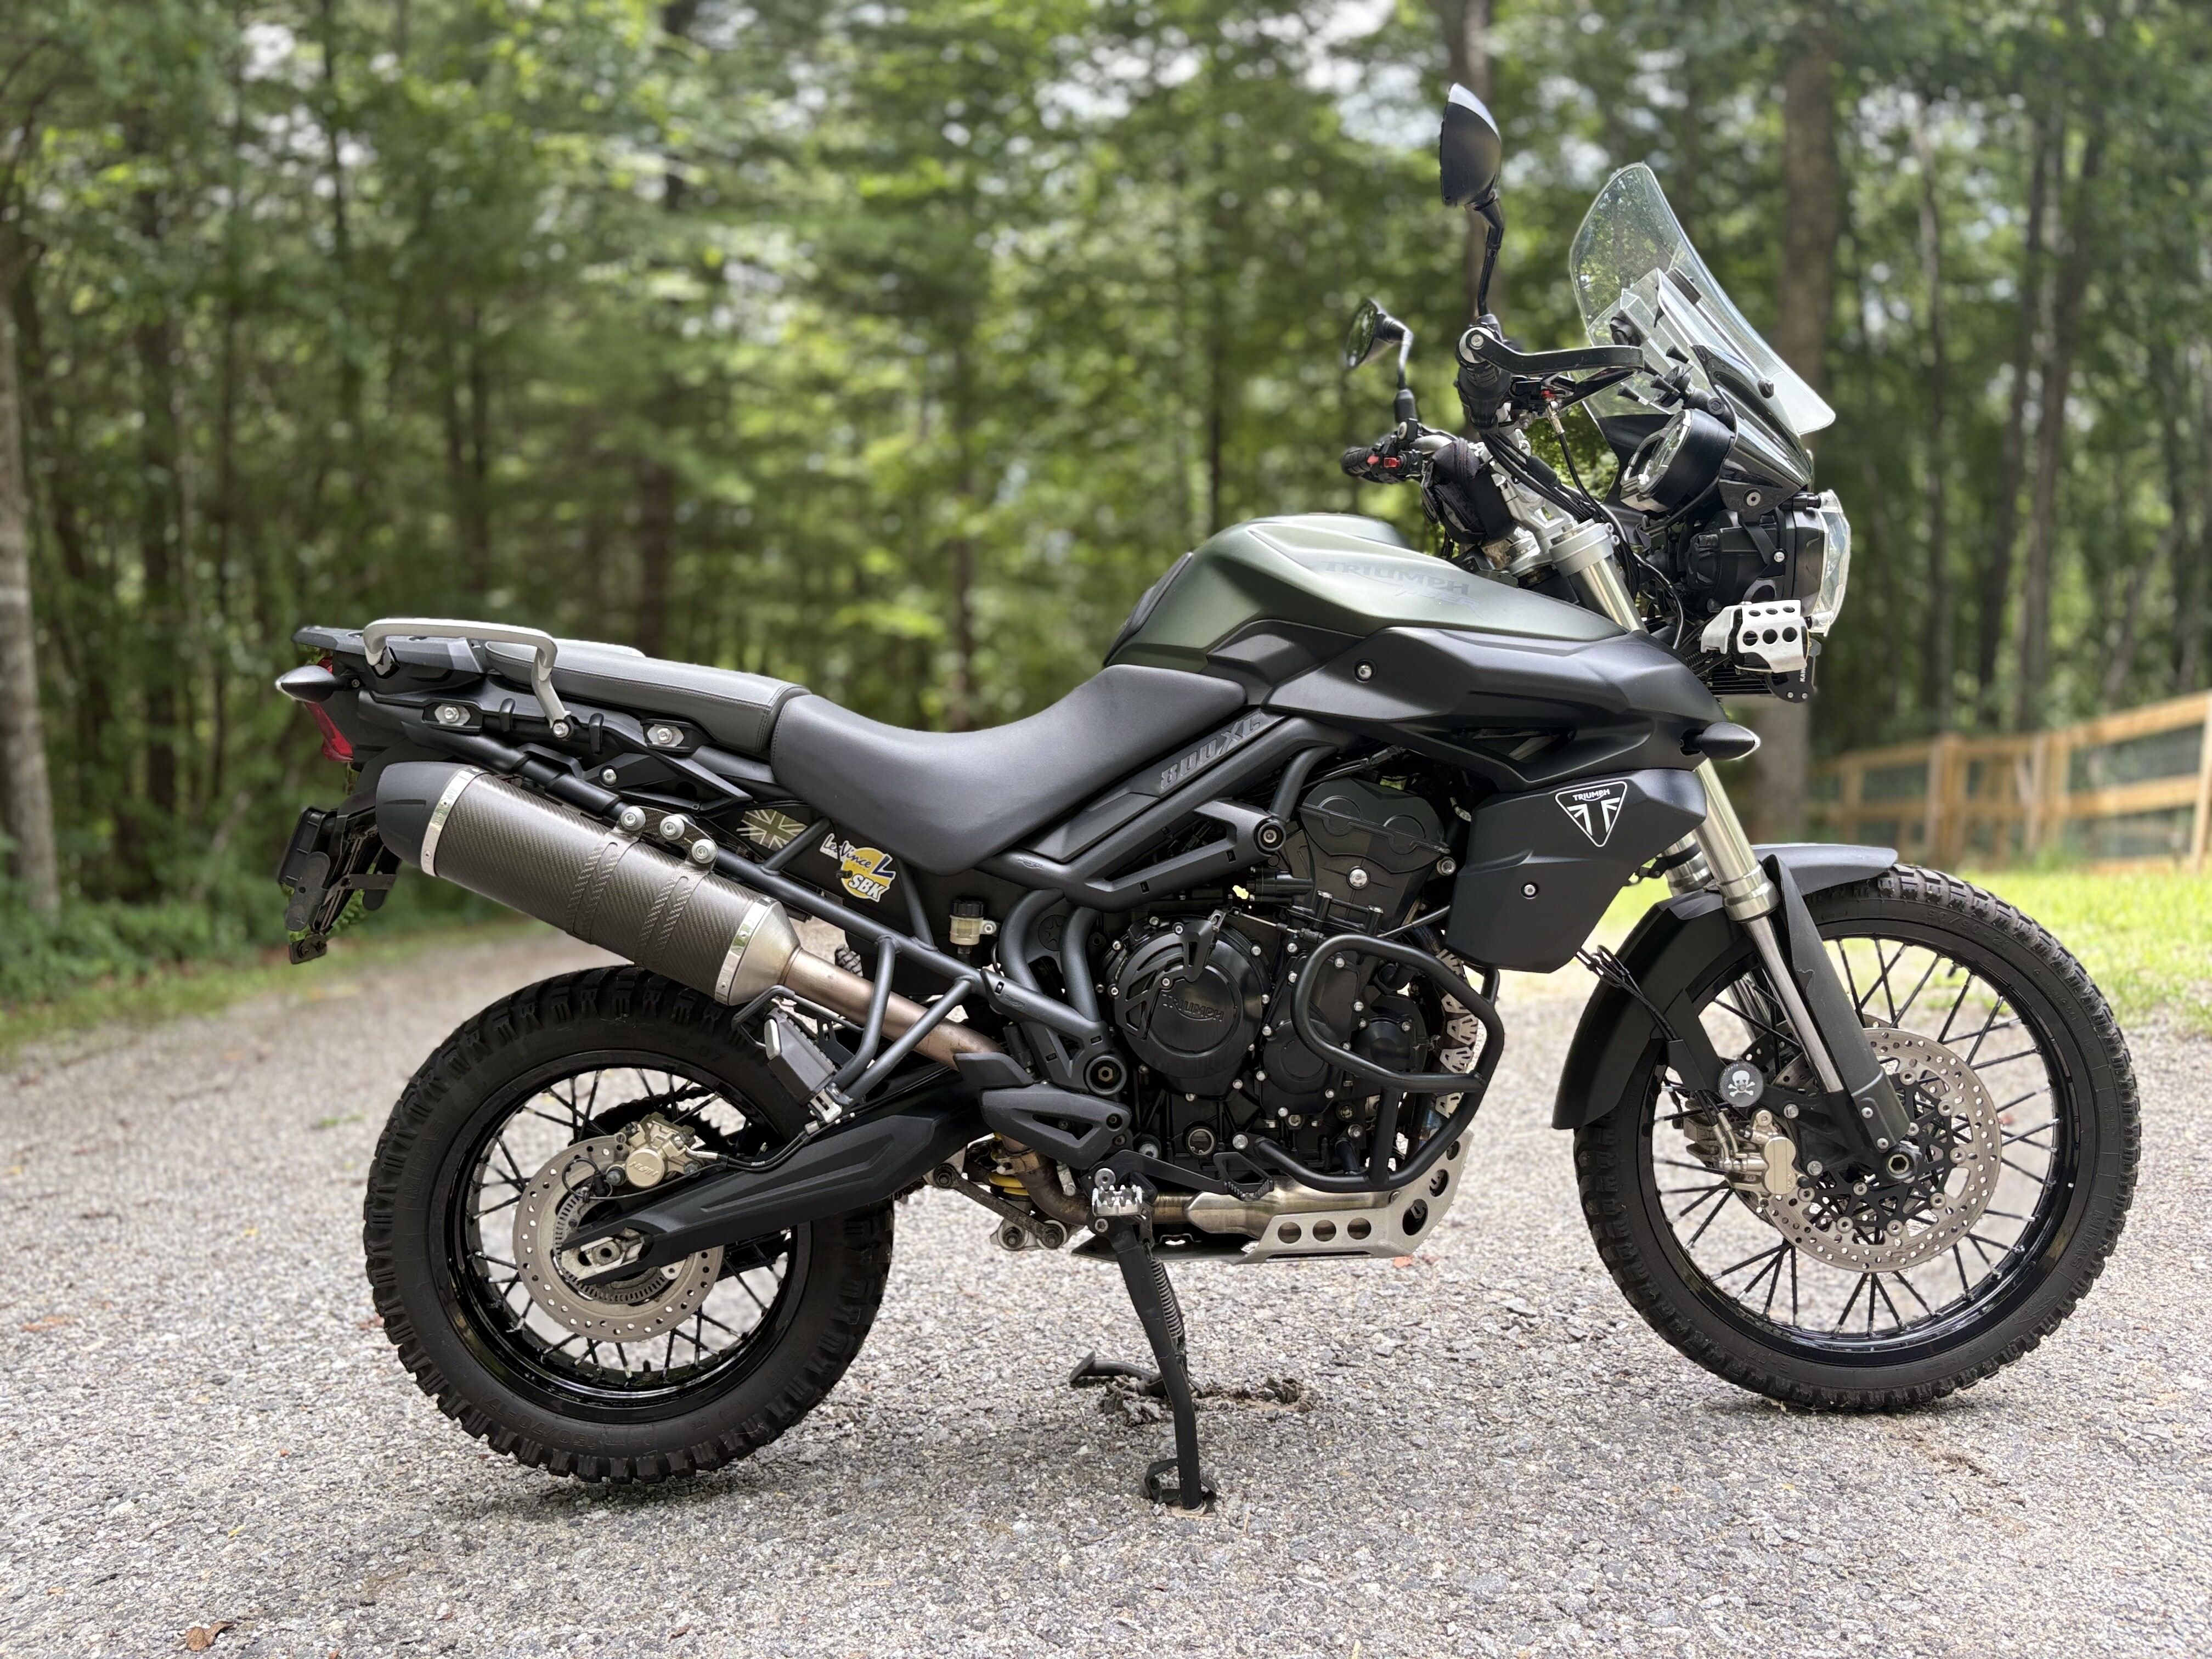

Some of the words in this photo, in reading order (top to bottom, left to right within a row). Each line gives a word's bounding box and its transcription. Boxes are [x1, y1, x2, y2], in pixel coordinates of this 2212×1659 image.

[1321, 561, 1469, 595] TRIUMPH
[1160, 712, 1261, 789] 800XC
[1572, 788, 1611, 801] TRIUMPH
[848, 874, 886, 900] SBK
[1161, 992, 1225, 1023] TRIUMPH
[2070, 1210, 2107, 1269] MITAS
